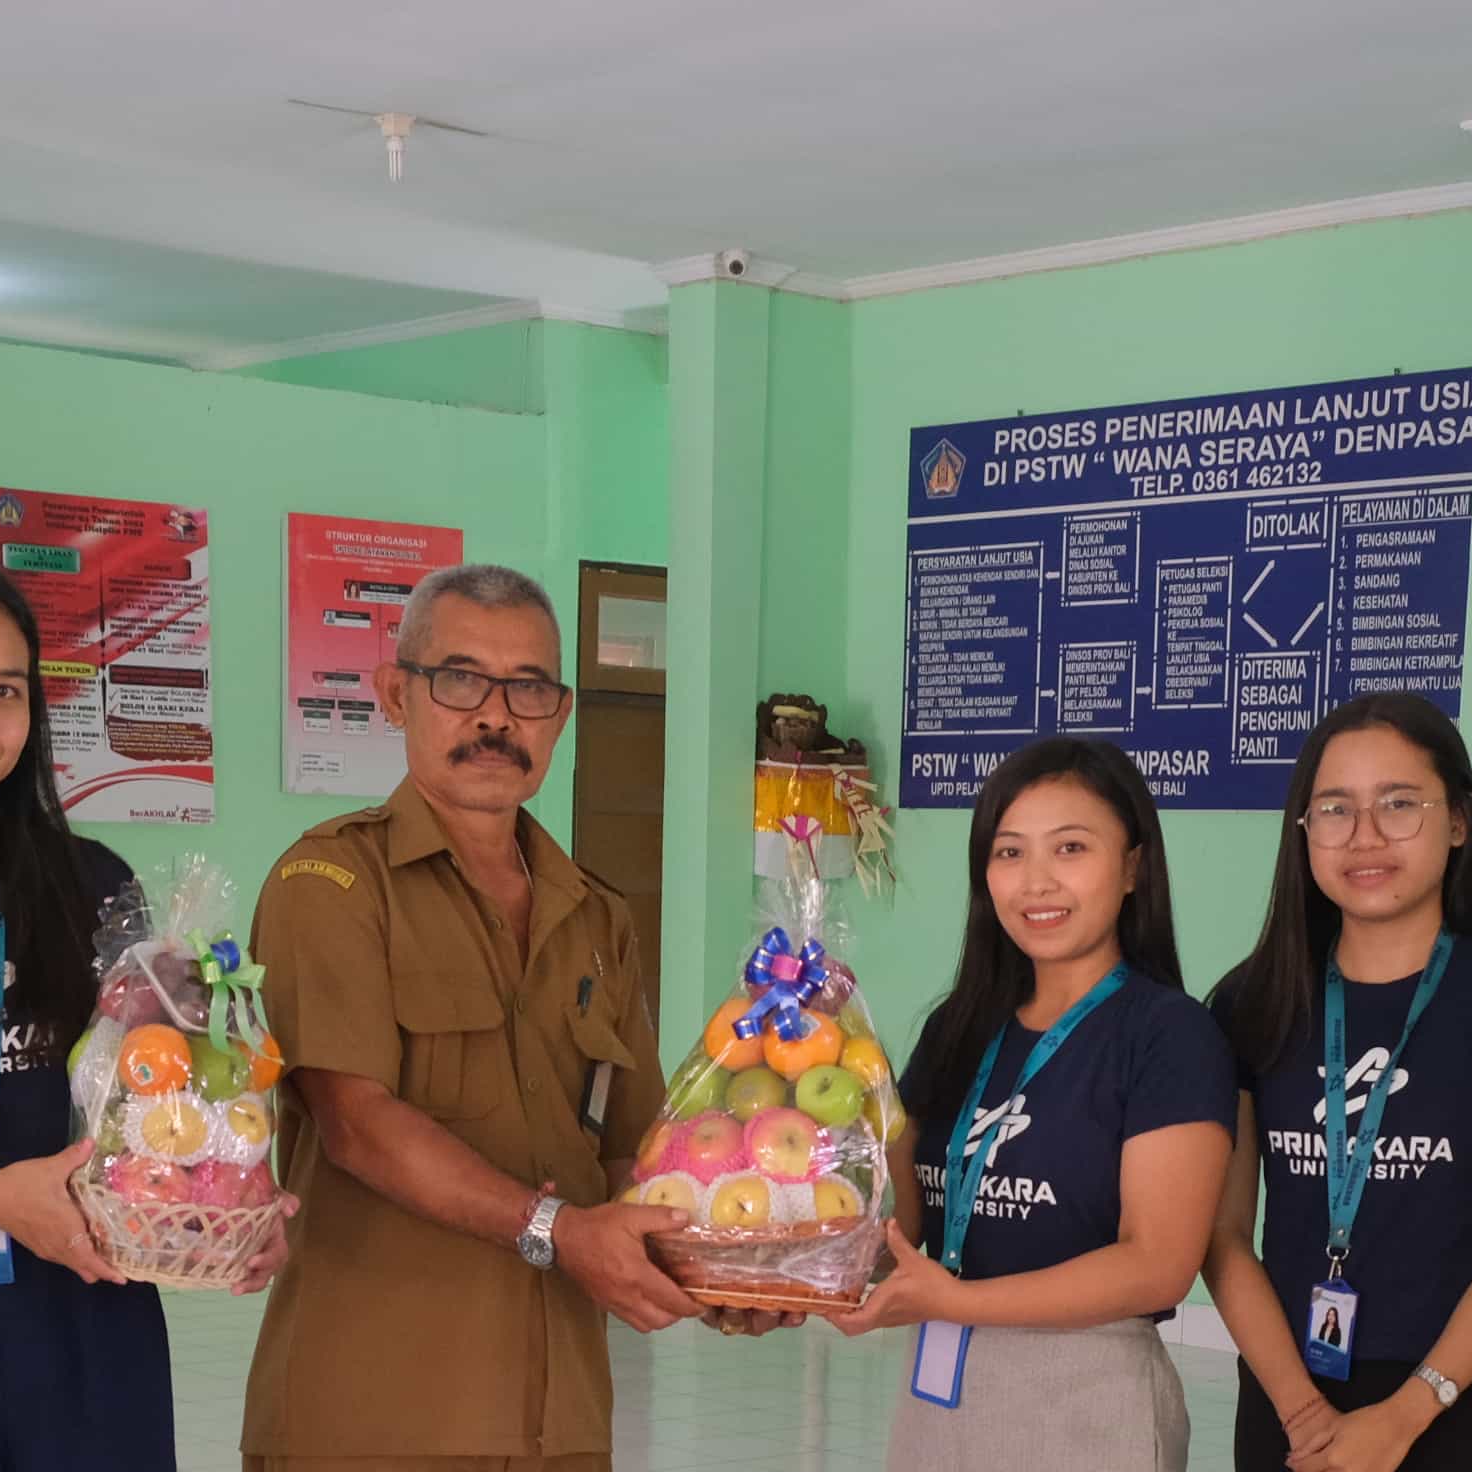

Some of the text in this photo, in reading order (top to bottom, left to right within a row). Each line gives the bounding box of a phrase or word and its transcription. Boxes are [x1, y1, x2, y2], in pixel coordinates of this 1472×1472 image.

[994, 420, 1097, 454] PROSES
[1104, 400, 1285, 444] PENERIMAAN
[1294, 387, 1411, 425] LANJUT
[983, 461, 1007, 487] DI
[1014, 452, 1087, 484] PSTW
[1130, 461, 1322, 497] TELP. 0361 462132
[1342, 495, 1469, 524] PELAYANAN DI DALAM
[1070, 520, 1128, 534] PERMOHONAN
[1253, 511, 1320, 539] DITOLAK
[1356, 529, 1436, 548] PENGASRAMAAN
[917, 550, 1033, 570] PERSYARATAN LANJUT USIA
[1099, 545, 1126, 557] KANTOR
[1355, 551, 1421, 569] PERMAKANAN
[1161, 566, 1228, 580] PETUGAS SELEKSI
[1354, 573, 1400, 590] SANDANG
[1353, 593, 1408, 610] KESEHATAN
[1352, 615, 1404, 631] BIMBINGAN
[1406, 613, 1441, 628] SOSIAL
[1351, 635, 1403, 651] BIMBINGAN
[1405, 633, 1459, 649] REKREATIF
[1241, 658, 1307, 681] DITERIMA
[1350, 656, 1402, 672] BIMBINGAN
[1404, 654, 1464, 670] KETRAMPILA
[1354, 675, 1463, 692] PENGISIAN WAKTU LUA
[1240, 684, 1302, 706] SEBAGAI
[1239, 711, 1311, 732] PENGHUNI
[1238, 736, 1278, 758] PANTI
[912, 750, 1209, 777] PSTW WA NPASAR
[930, 781, 954, 796] UPTD
[955, 781, 984, 796] PELAY
[1163, 781, 1186, 796] BALI
[1290, 1158, 1427, 1180] UNISITY
[915, 1164, 1057, 1206] RIKARA
[926, 1191, 1031, 1220] UNRSITY
